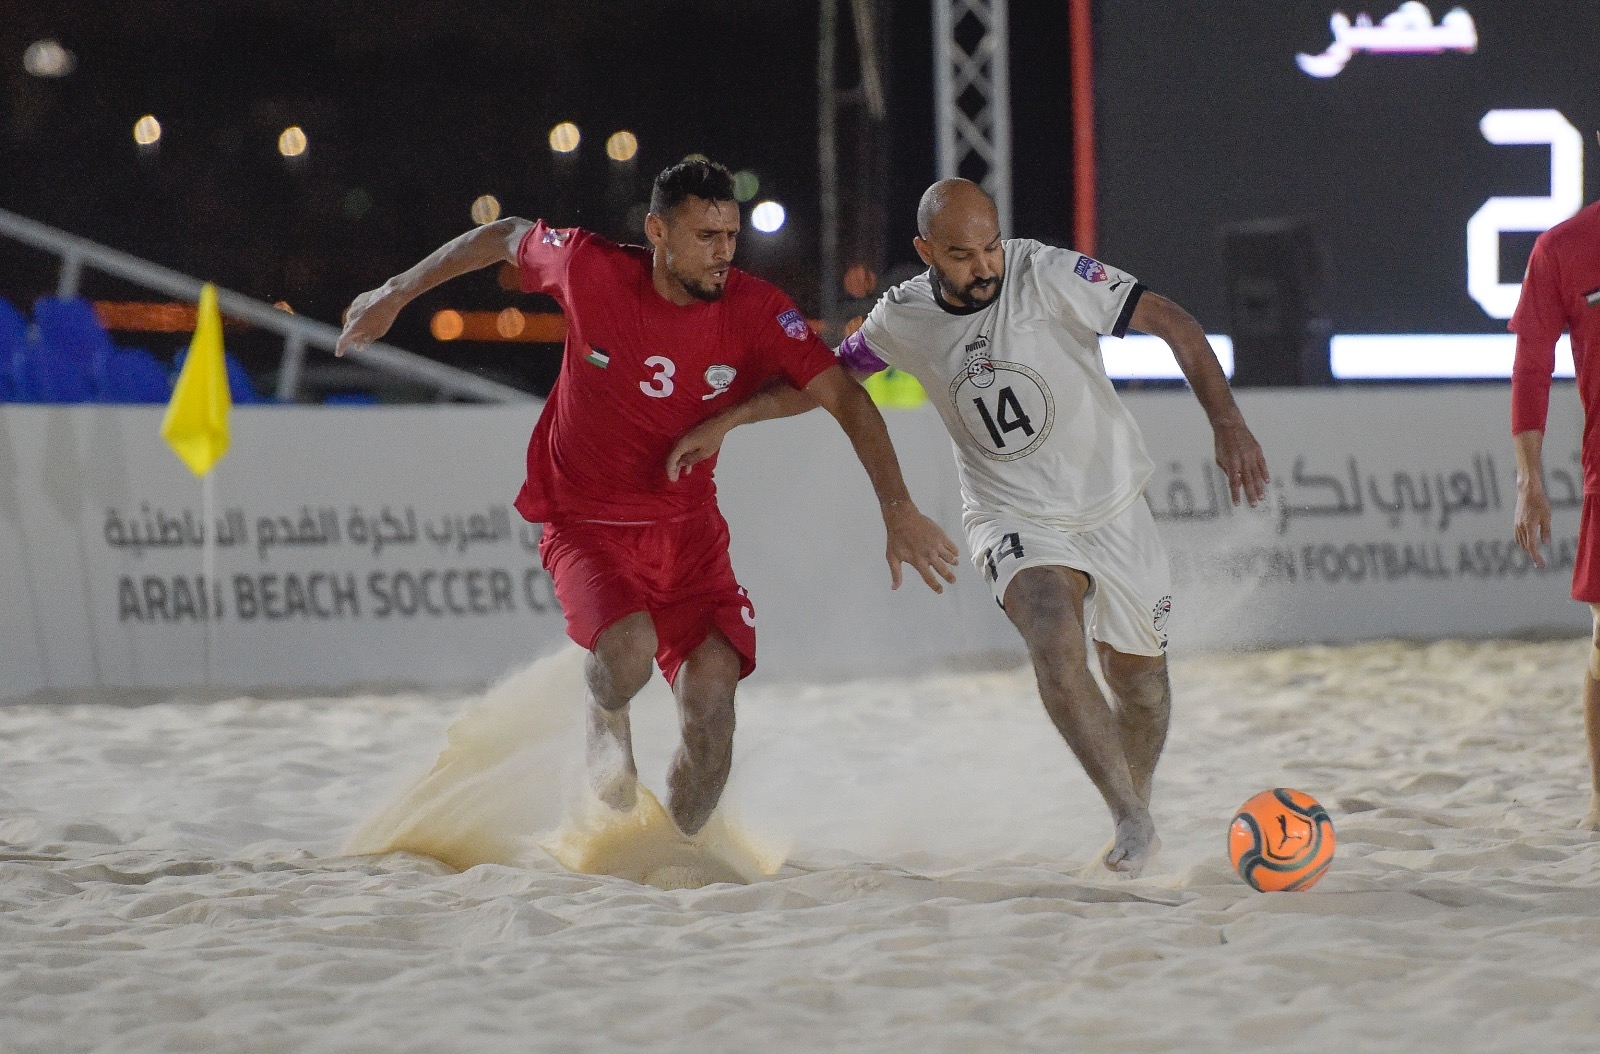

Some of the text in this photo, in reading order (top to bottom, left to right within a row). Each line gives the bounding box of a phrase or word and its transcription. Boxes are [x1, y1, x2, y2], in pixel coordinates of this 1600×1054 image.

[1296, 1, 1478, 77] مصر
[1467, 108, 1583, 320] 2
[965, 340, 986, 352] PUMA
[639, 355, 676, 398] 3
[972, 386, 1035, 448] 14
[1268, 453, 1364, 536] لكر
[1368, 451, 1501, 532] العربي
[346, 505, 418, 557] لكرة
[424, 504, 512, 555] العرب
[984, 532, 1024, 583] 14
[1301, 541, 1450, 583] FOOTBALL
[232, 571, 361, 621] BEACH
[367, 568, 515, 620] SOCCER
